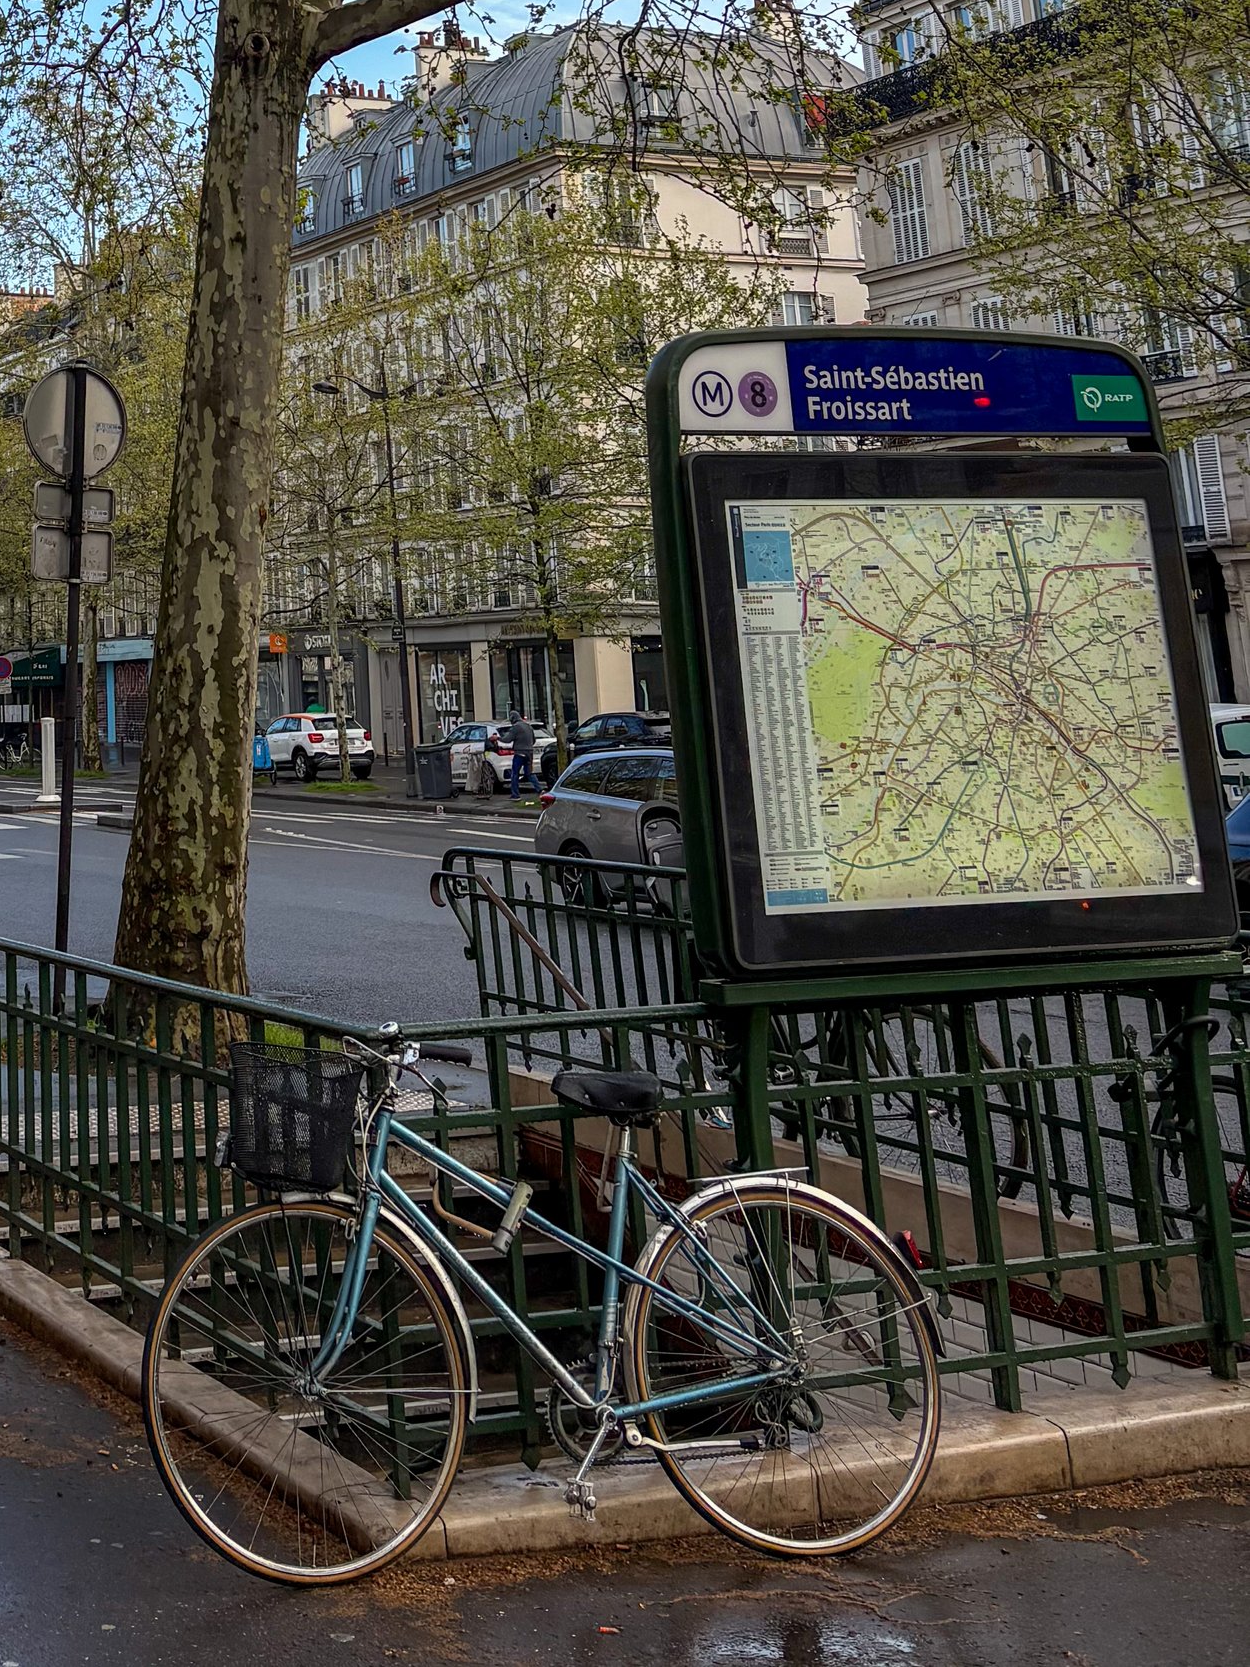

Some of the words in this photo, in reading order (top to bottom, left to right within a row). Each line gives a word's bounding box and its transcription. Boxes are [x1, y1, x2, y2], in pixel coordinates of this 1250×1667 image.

[803, 364, 985, 391] Saint-Sébastien
[701, 381, 725, 407] M
[750, 380, 767, 408] 8
[1104, 393, 1134, 402] RATP
[806, 395, 913, 420] Froissart
[429, 663, 447, 685] AR
[434, 689, 459, 712] CHI
